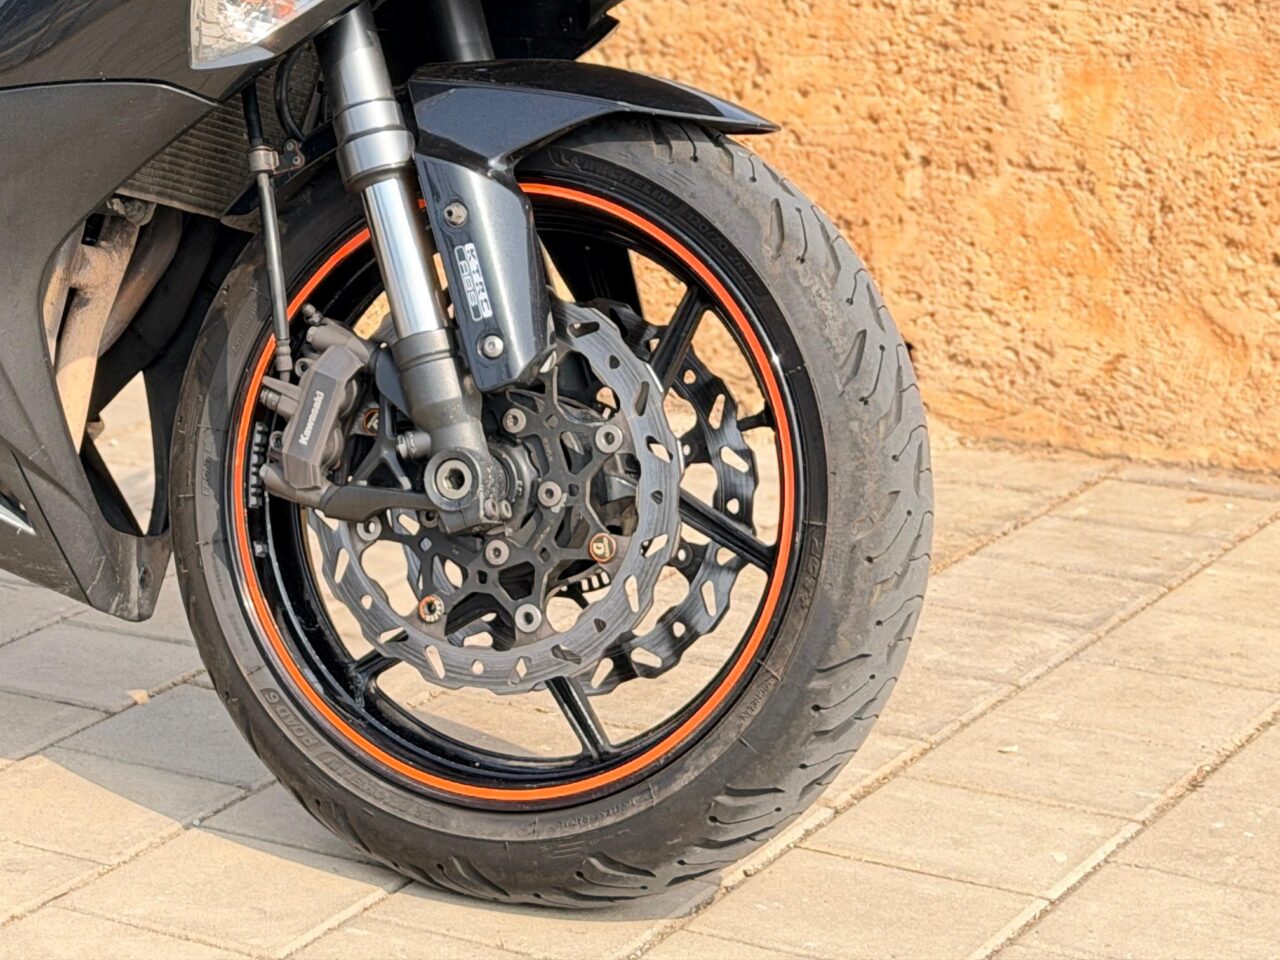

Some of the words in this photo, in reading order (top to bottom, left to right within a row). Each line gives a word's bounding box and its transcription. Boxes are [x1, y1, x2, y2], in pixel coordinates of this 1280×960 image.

[459, 259, 479, 308] ABS
[466, 246, 491, 313] KTRC
[297, 390, 325, 446] Kawasaki
